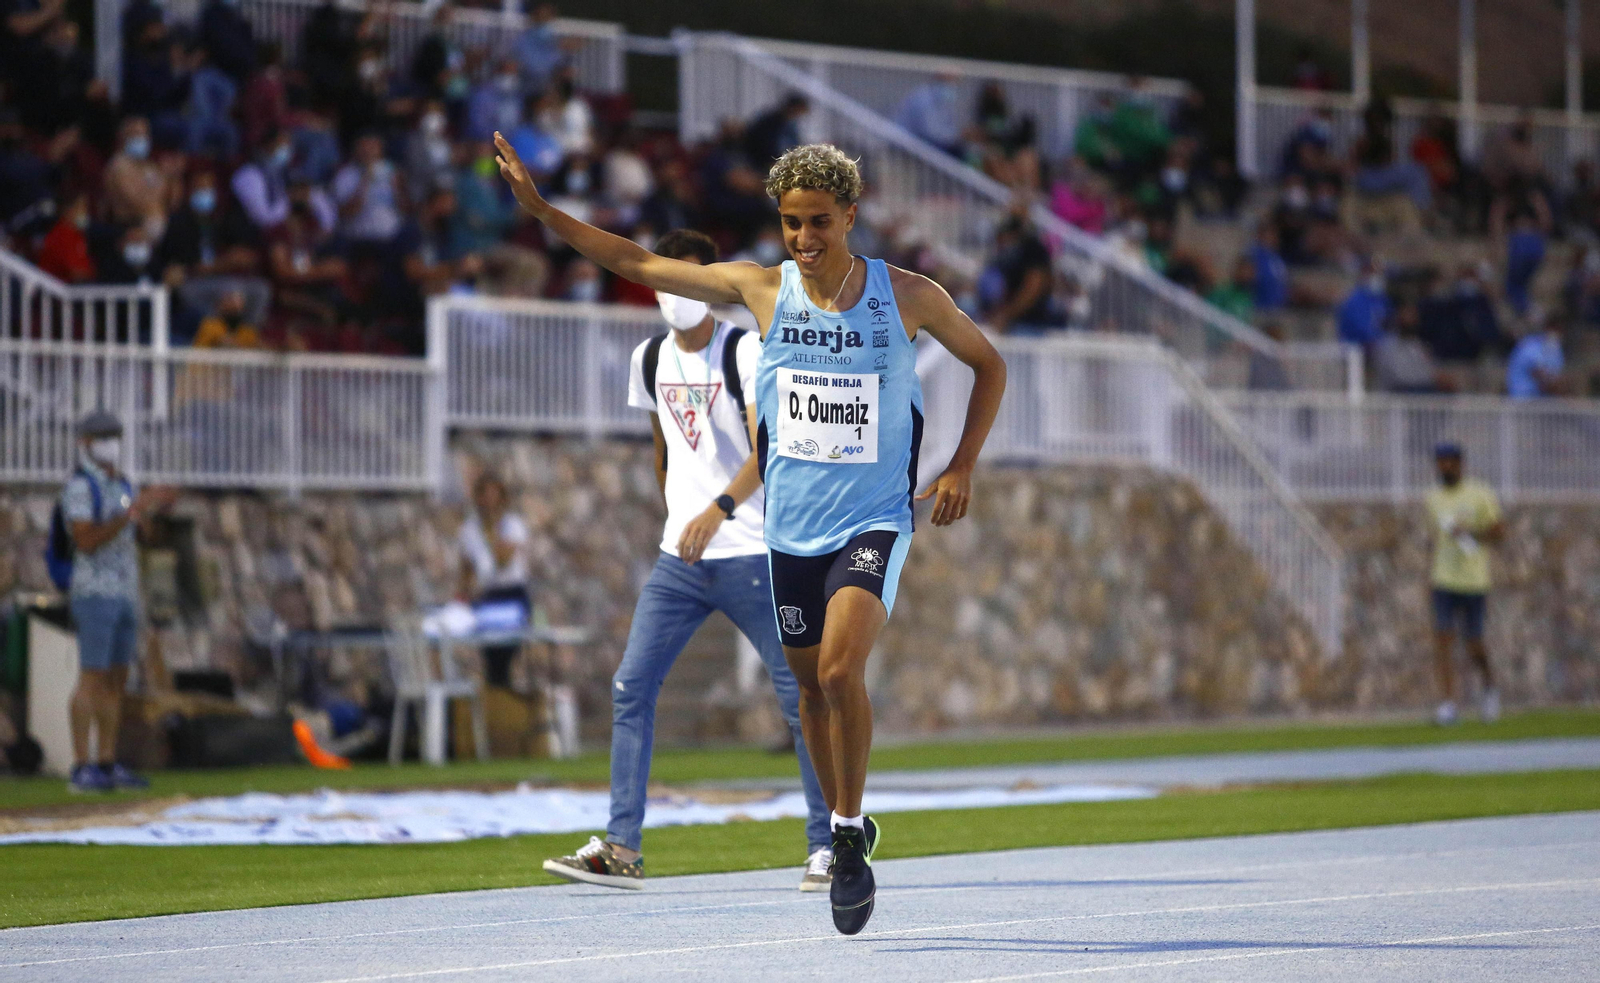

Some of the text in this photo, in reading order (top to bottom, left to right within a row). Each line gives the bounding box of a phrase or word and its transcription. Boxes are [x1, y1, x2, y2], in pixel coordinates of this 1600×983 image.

[781, 325, 864, 353] nerja
[792, 353, 852, 365] ATLETISMO
[793, 374, 862, 388] DESAFÍO NERJA
[808, 393, 869, 425] Oumaiz
[854, 426, 862, 440] 1
